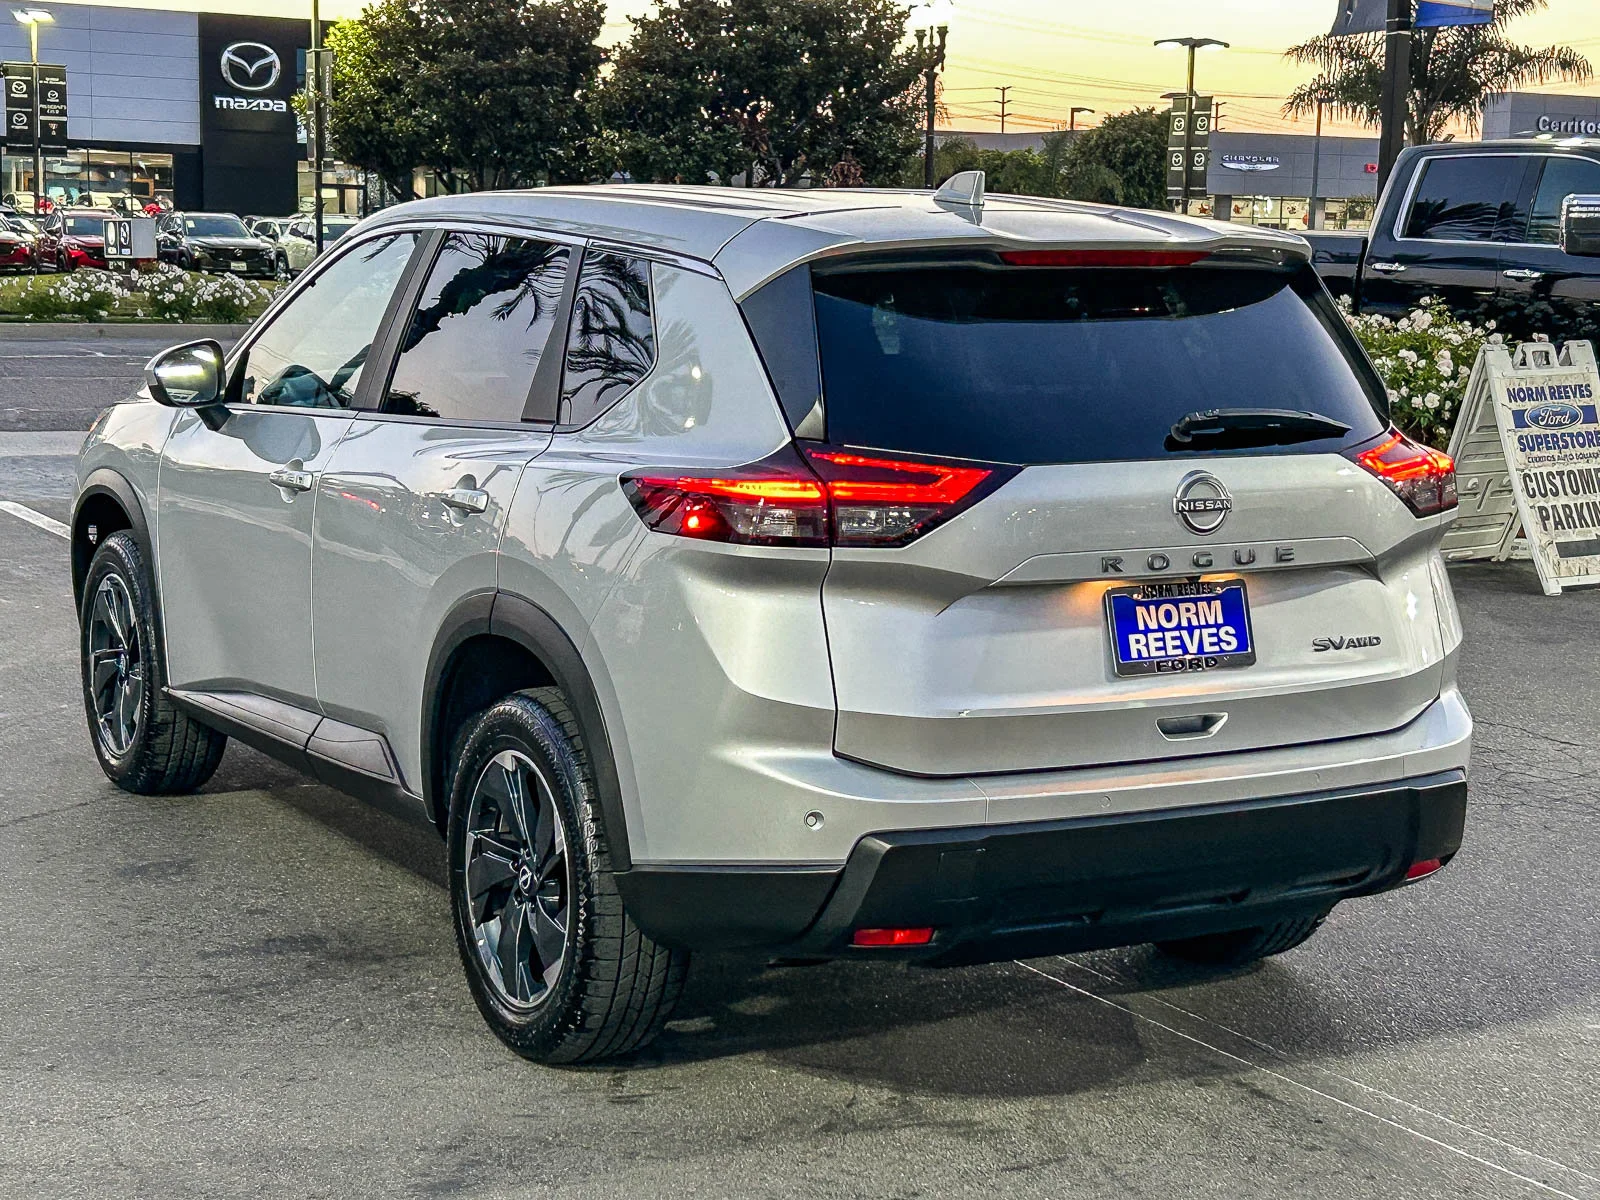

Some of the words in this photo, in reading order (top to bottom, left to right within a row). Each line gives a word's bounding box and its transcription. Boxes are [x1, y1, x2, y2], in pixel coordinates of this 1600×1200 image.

[1507, 386, 1547, 403] NORM
[1548, 383, 1592, 400] REEVES
[1538, 406, 1571, 426] Ford
[1518, 430, 1600, 452] SUPERSTORE
[1178, 500, 1232, 512] NISSAN
[1101, 547, 1295, 573] ROGUE
[1176, 583, 1212, 597] REEVES
[1135, 600, 1224, 630] NORM
[1128, 625, 1238, 659] REEVES
[1155, 657, 1218, 673] FORD
